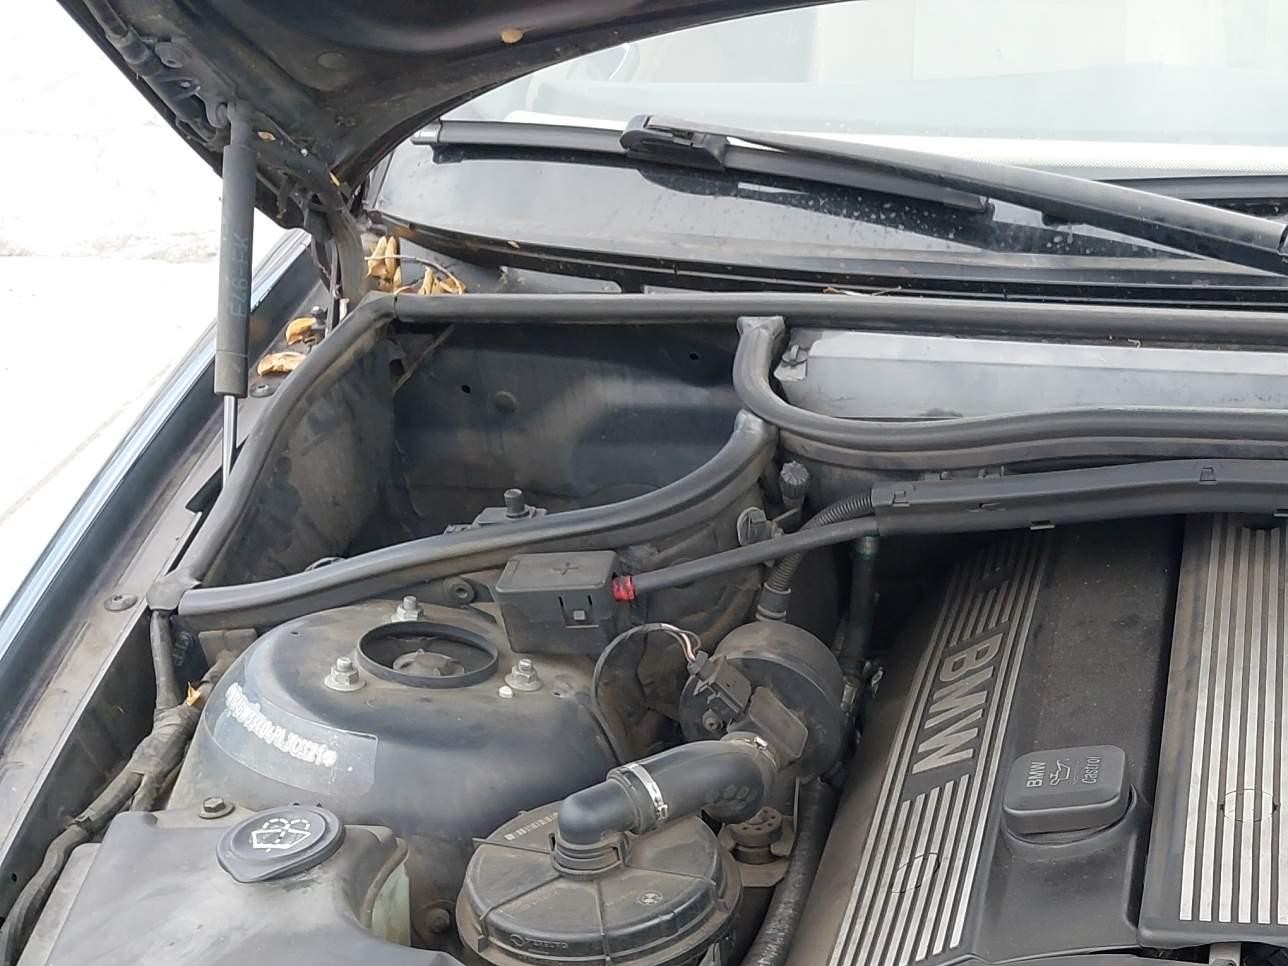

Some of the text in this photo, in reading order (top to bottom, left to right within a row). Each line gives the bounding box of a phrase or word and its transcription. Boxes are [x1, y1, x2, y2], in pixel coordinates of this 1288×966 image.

[911, 632, 1004, 775] BMW
[1026, 760, 1046, 788] BMW
[1081, 756, 1101, 784] Castrol
